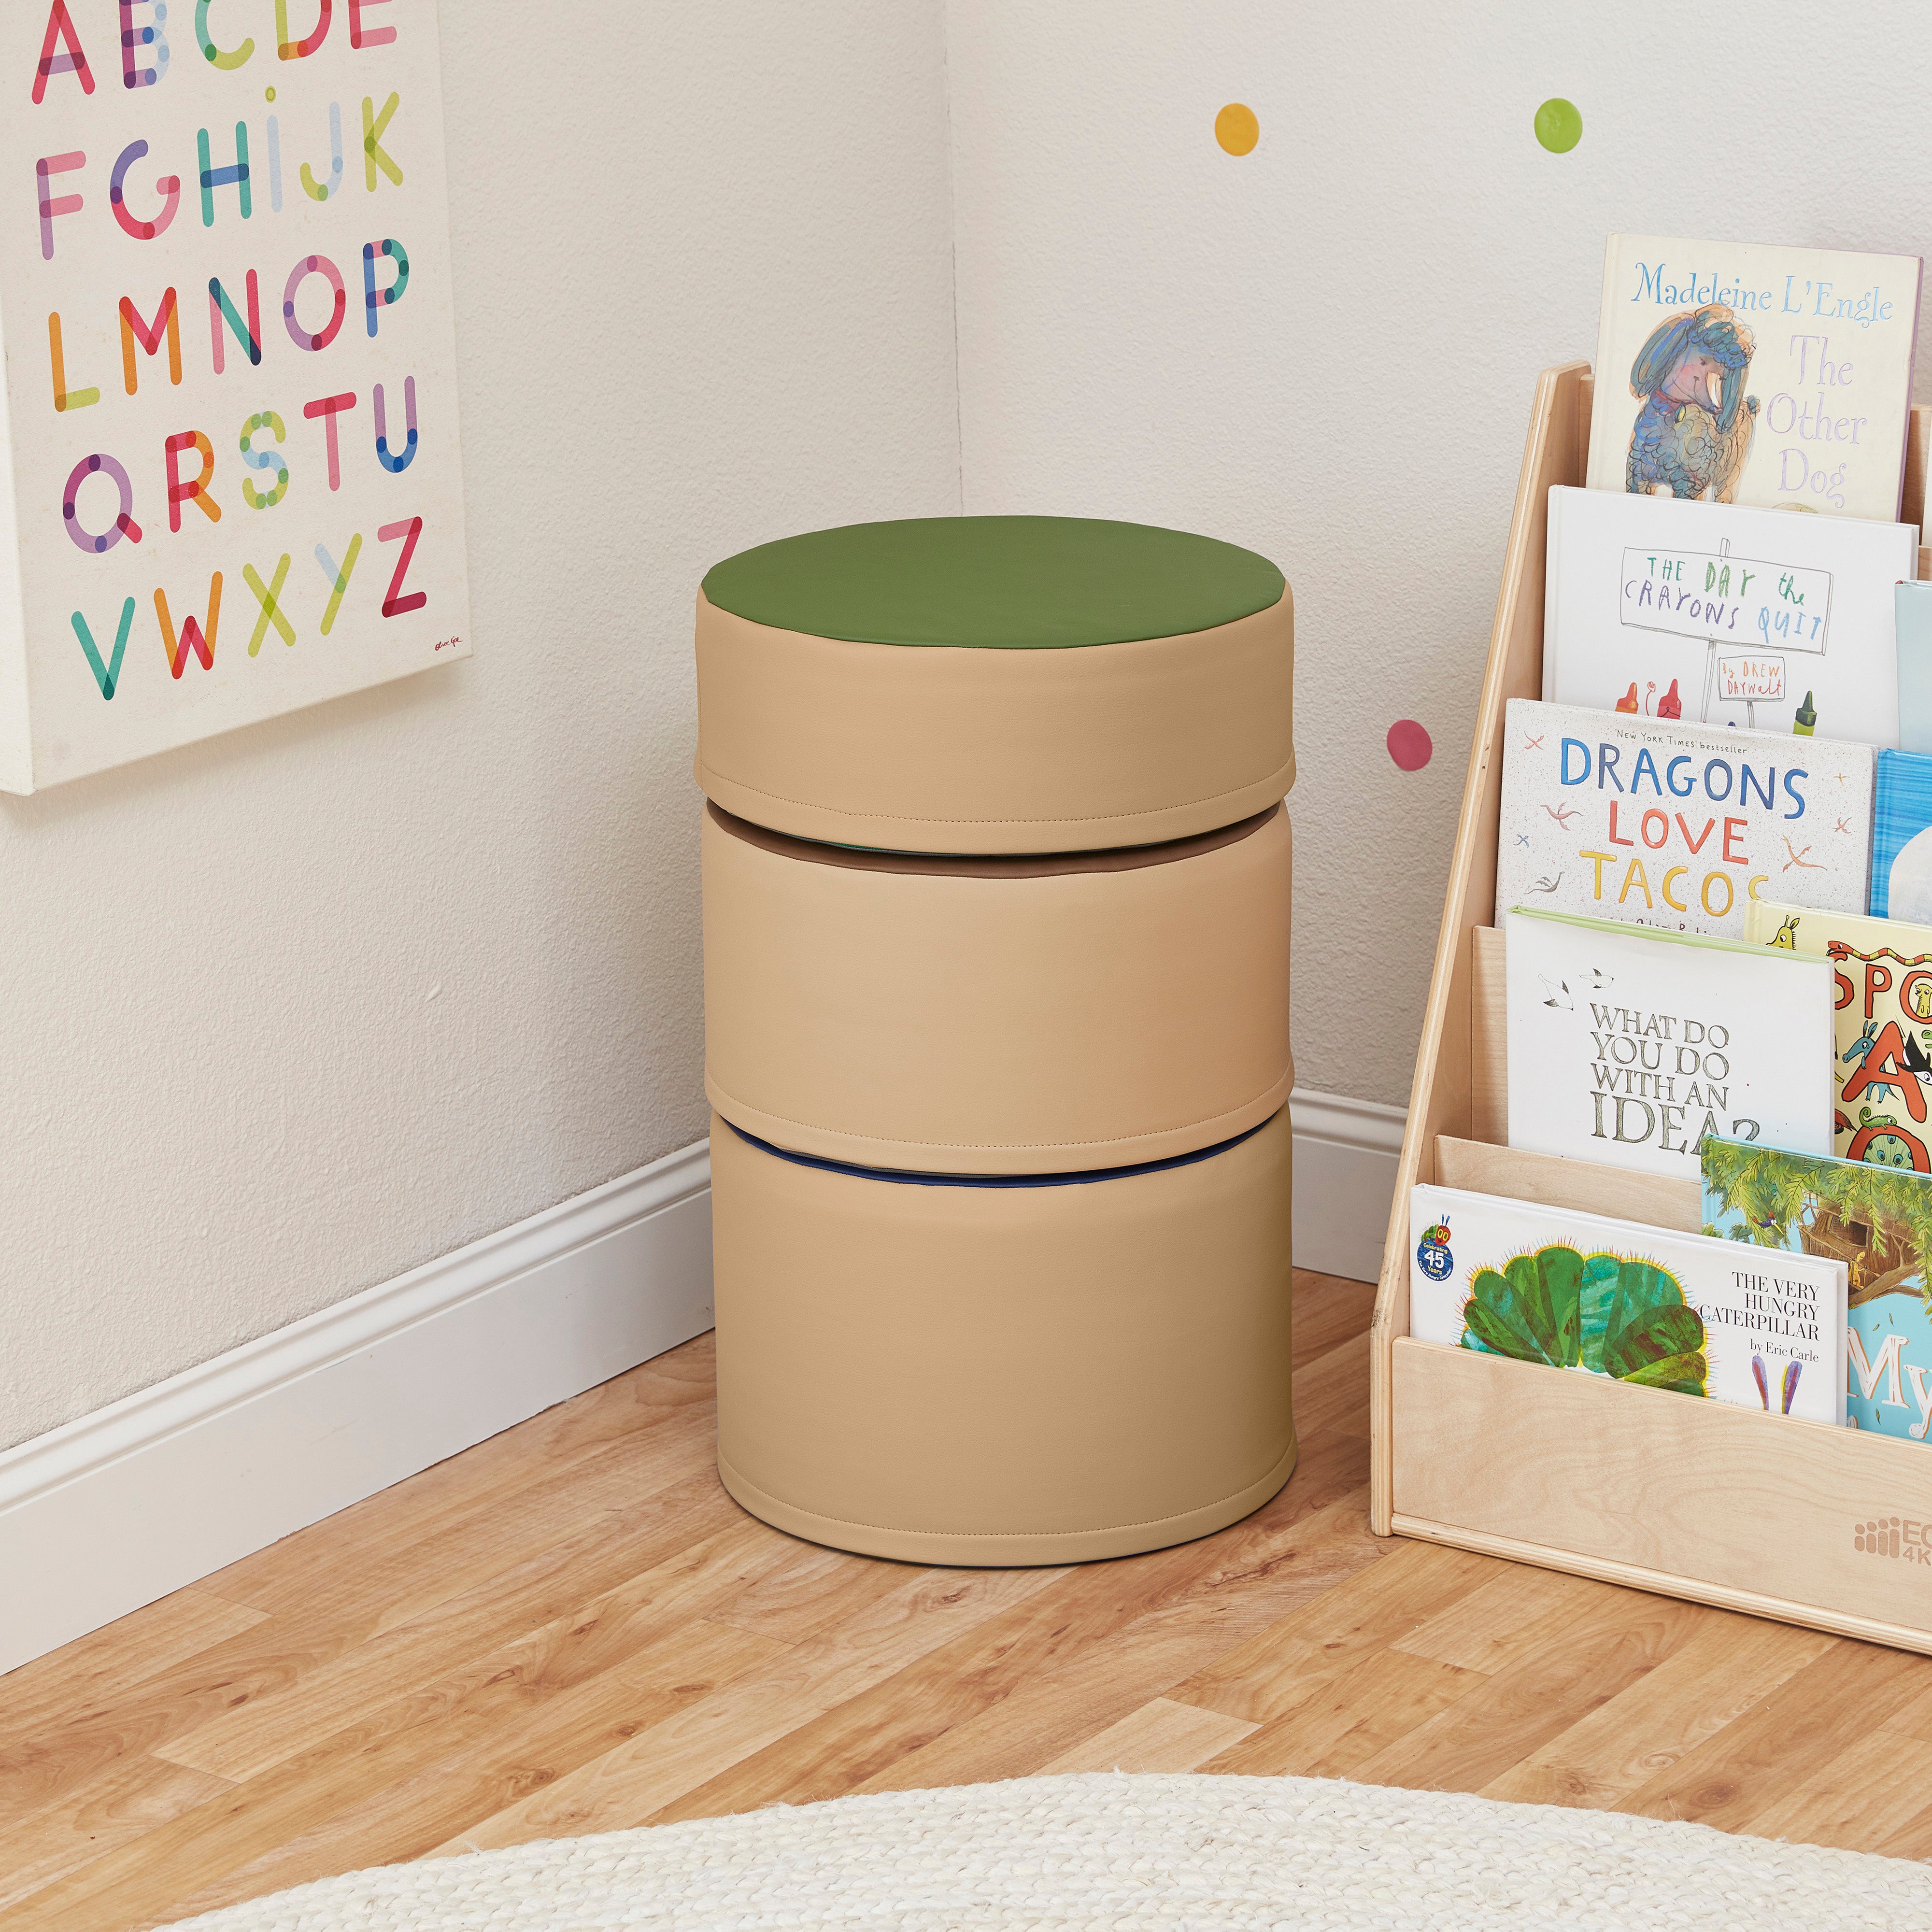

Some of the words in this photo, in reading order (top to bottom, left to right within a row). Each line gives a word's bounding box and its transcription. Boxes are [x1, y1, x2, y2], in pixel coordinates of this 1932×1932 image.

[1631, 262, 1773, 311] Madeleine
[1781, 275, 1893, 328] L'Engle
[1790, 335, 1854, 386] The
[1766, 392, 1867, 445] Other
[1778, 448, 1847, 508] Dog
[1648, 557, 1686, 581] THE
[1704, 561, 1756, 598] DAY
[1778, 572, 1804, 606] the
[1625, 579, 1739, 629] CRAYONS
[1758, 606, 1821, 643] QUIT
[1722, 663, 1734, 679] By
[1743, 661, 1780, 677] DREW
[1617, 729, 1636, 739] NEW
[1641, 732, 1663, 743] YORK
[1667, 735, 1694, 748] TIMES
[1700, 741, 1747, 754] bestseller
[1561, 738, 1809, 820] DRAGONS
[1609, 800, 1749, 866] LOVE
[1590, 1003, 1677, 1040] WHAT
[1684, 1020, 1729, 1049] DO
[1590, 1032, 1663, 1070] YOU
[1675, 1046, 1730, 1080] DO
[1590, 1063, 1676, 1102] WITH
[1684, 1081, 1730, 1111] AN
[1423, 1242, 1448, 1254] Celebrating
[1424, 1250, 1444, 1268] 45
[1427, 1265, 1443, 1275] Years
[1732, 1271, 1769, 1293] THE
[1773, 1278, 1820, 1302] VERY
[1745, 1293, 1820, 1321] HUNGRY
[1700, 1304, 1820, 1341] CATERPILLAR
[1750, 1338, 1763, 1355] by
[1765, 1341, 1787, 1357] Eric
[1790, 1346, 1819, 1363] Carle
